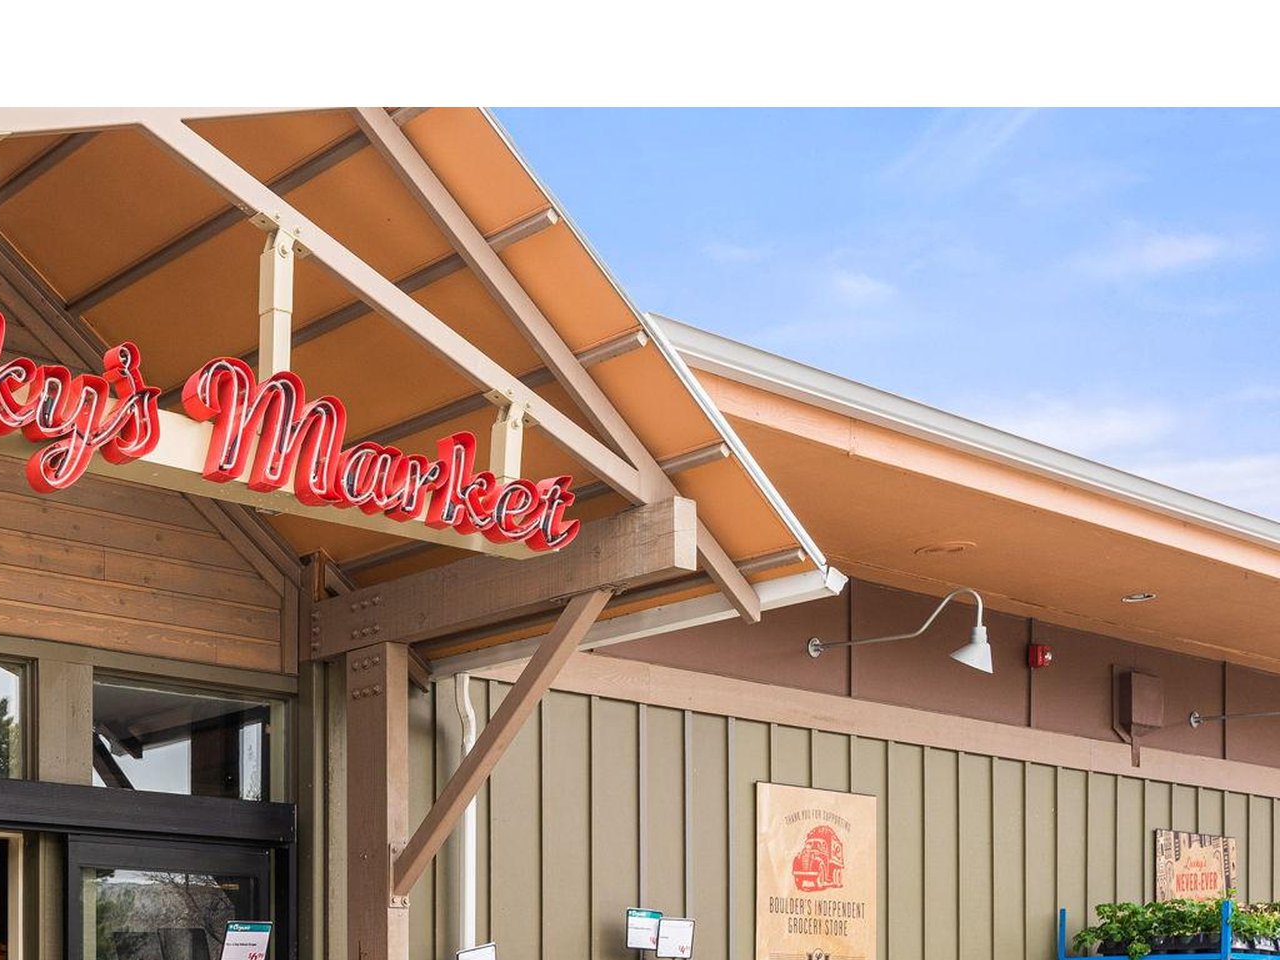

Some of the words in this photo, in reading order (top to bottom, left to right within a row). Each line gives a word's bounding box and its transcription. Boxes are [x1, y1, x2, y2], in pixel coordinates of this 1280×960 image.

[183, 356, 580, 551] Market
[1175, 871, 1218, 892] NEVER-EVER
[769, 896, 812, 916] BOULDER'S
[814, 900, 865, 919] INDEPENDENT
[788, 917, 822, 935] GROCERY
[824, 919, 848, 936] STORE
